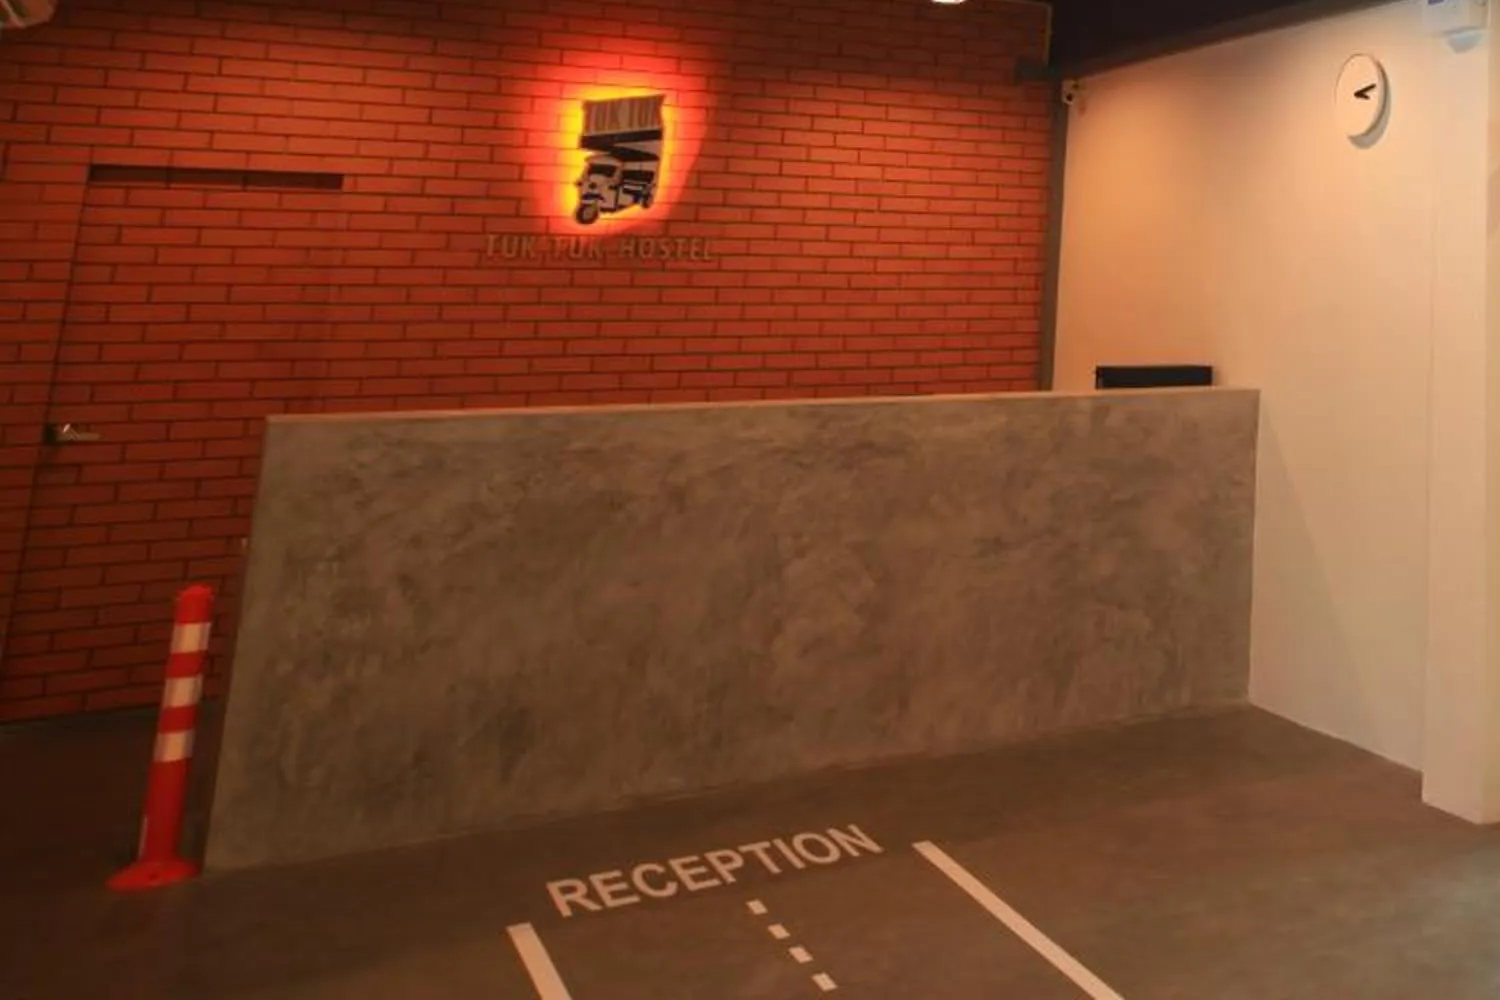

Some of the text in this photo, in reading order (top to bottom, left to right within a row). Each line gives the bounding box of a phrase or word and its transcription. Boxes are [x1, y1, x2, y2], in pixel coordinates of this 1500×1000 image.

[486, 234, 536, 258] TUK
[619, 236, 714, 260] HOSTEL
[546, 824, 884, 918] RECEPTION
